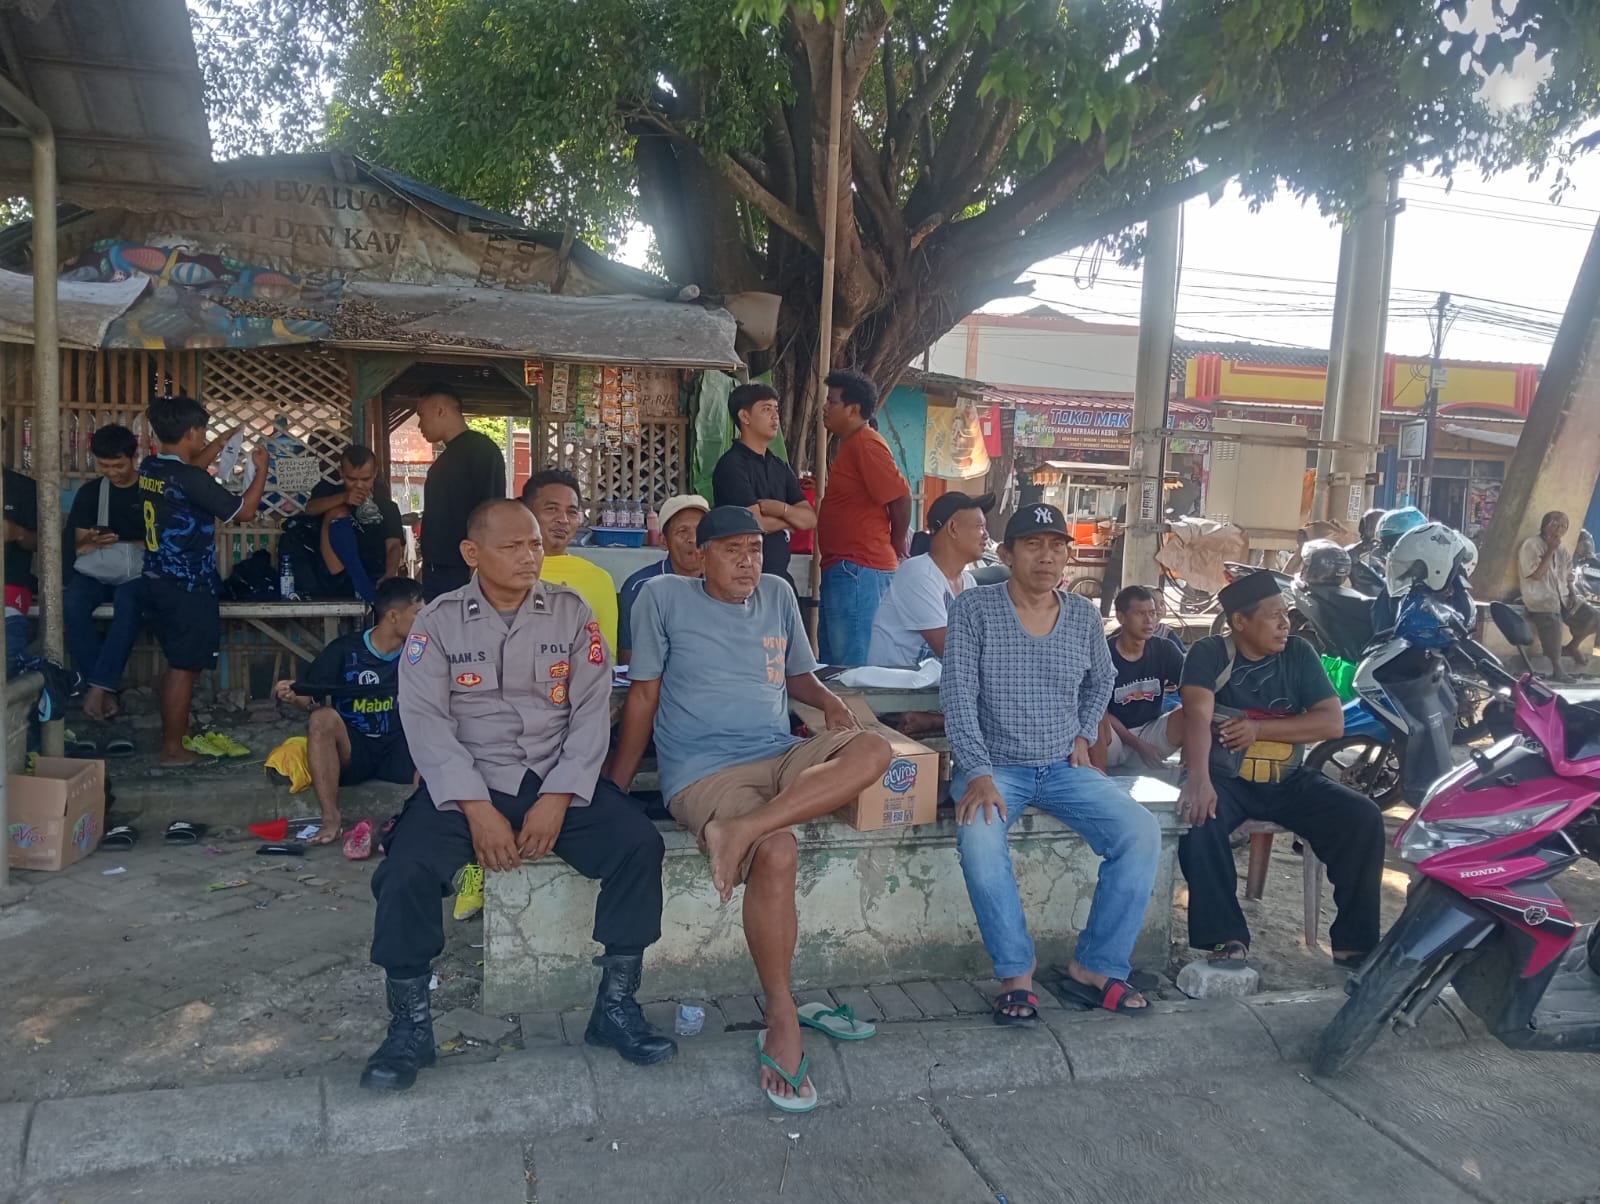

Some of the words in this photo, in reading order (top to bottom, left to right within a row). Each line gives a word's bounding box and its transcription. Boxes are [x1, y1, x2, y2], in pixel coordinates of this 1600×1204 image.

[1051, 408, 1093, 427] TOKO
[1094, 411, 1132, 428] MAK
[1195, 416, 1207, 428] 24
[1072, 428, 1100, 436] BERBAGAI
[143, 500, 159, 552] 8
[1460, 866, 1507, 879] HONDA
